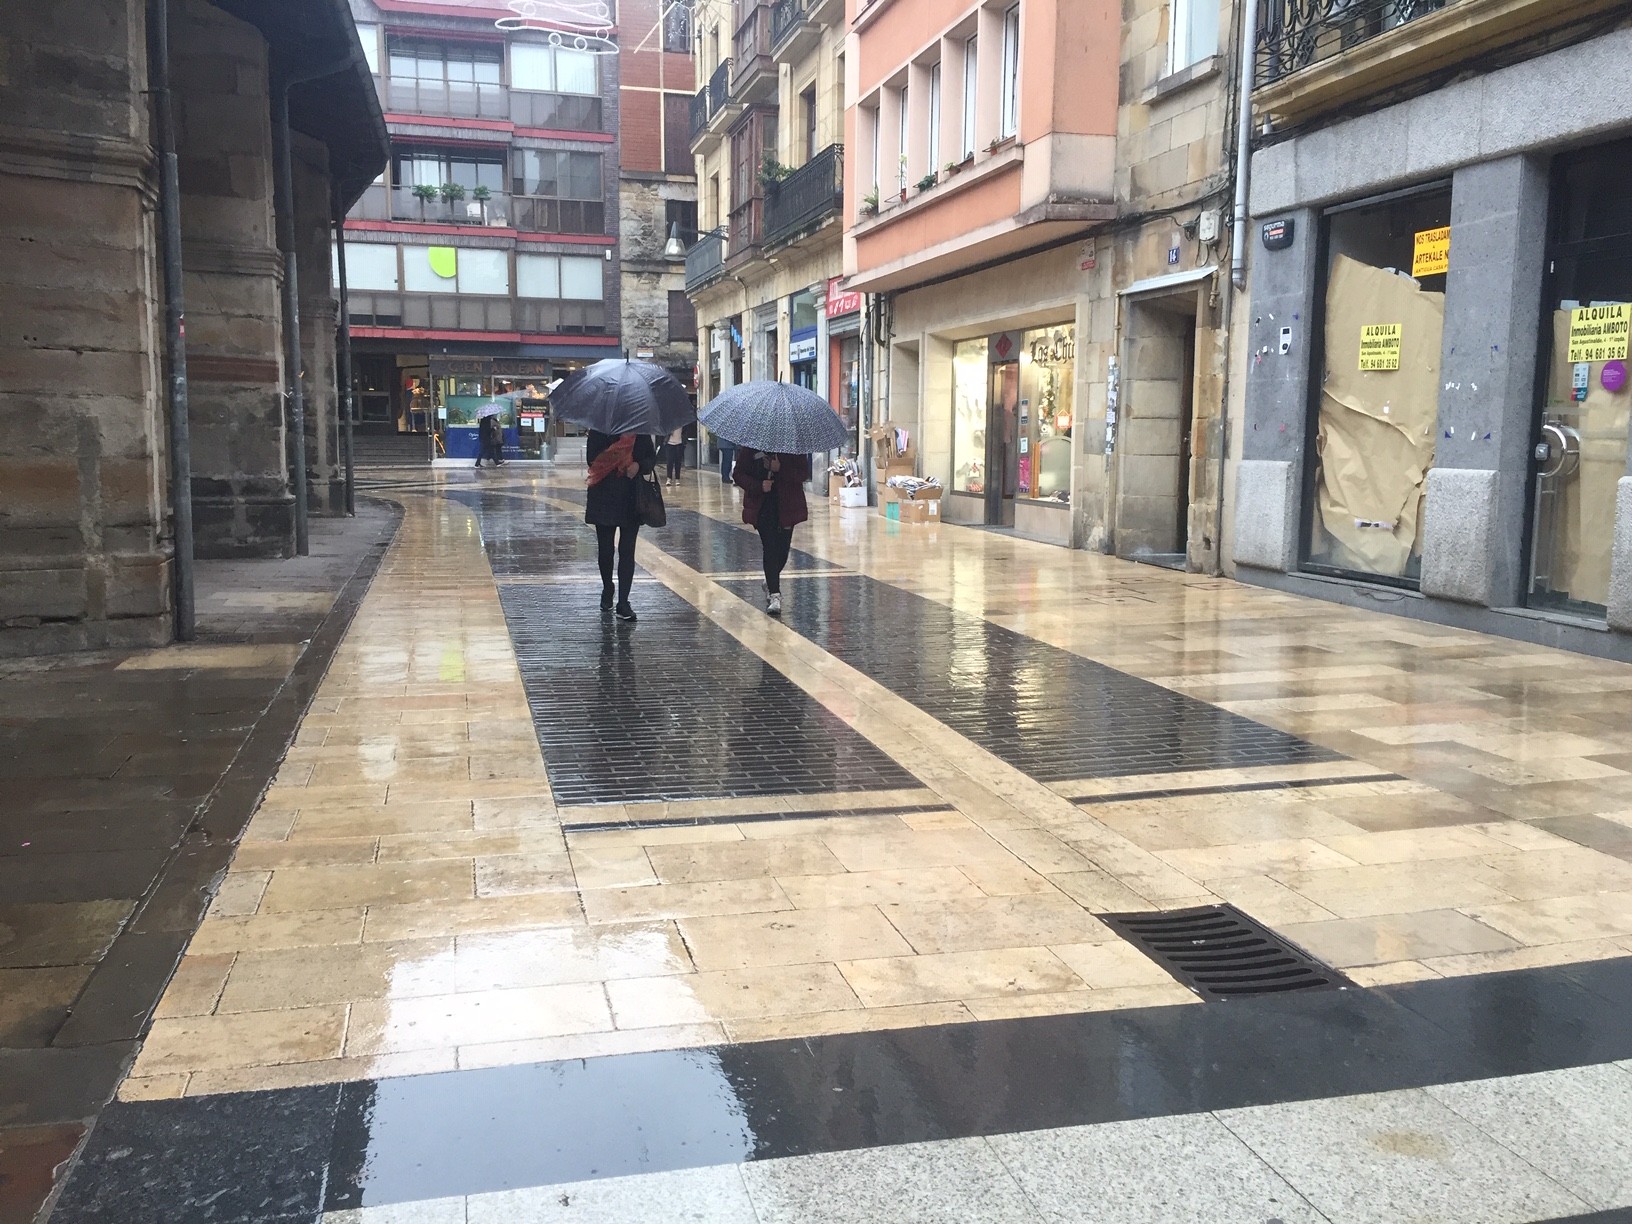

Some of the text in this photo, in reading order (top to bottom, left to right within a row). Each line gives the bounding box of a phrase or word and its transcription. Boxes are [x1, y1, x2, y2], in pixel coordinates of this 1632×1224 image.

[1416, 234, 1424, 245] NOS
[1415, 250, 1443, 264] ARTEKALE
[1578, 306, 1622, 321] ALQUILA
[1366, 325, 1396, 336] ALQUILA
[1571, 322, 1628, 337] Inmobiliaria AMBOTO
[1382, 338, 1400, 348] AMBOTO
[1029, 339, 1049, 364] Los
[1585, 348, 1593, 360] 94
[1595, 347, 1605, 359] 681
[1607, 346, 1615, 358] 35
[1617, 346, 1625, 358] 62
